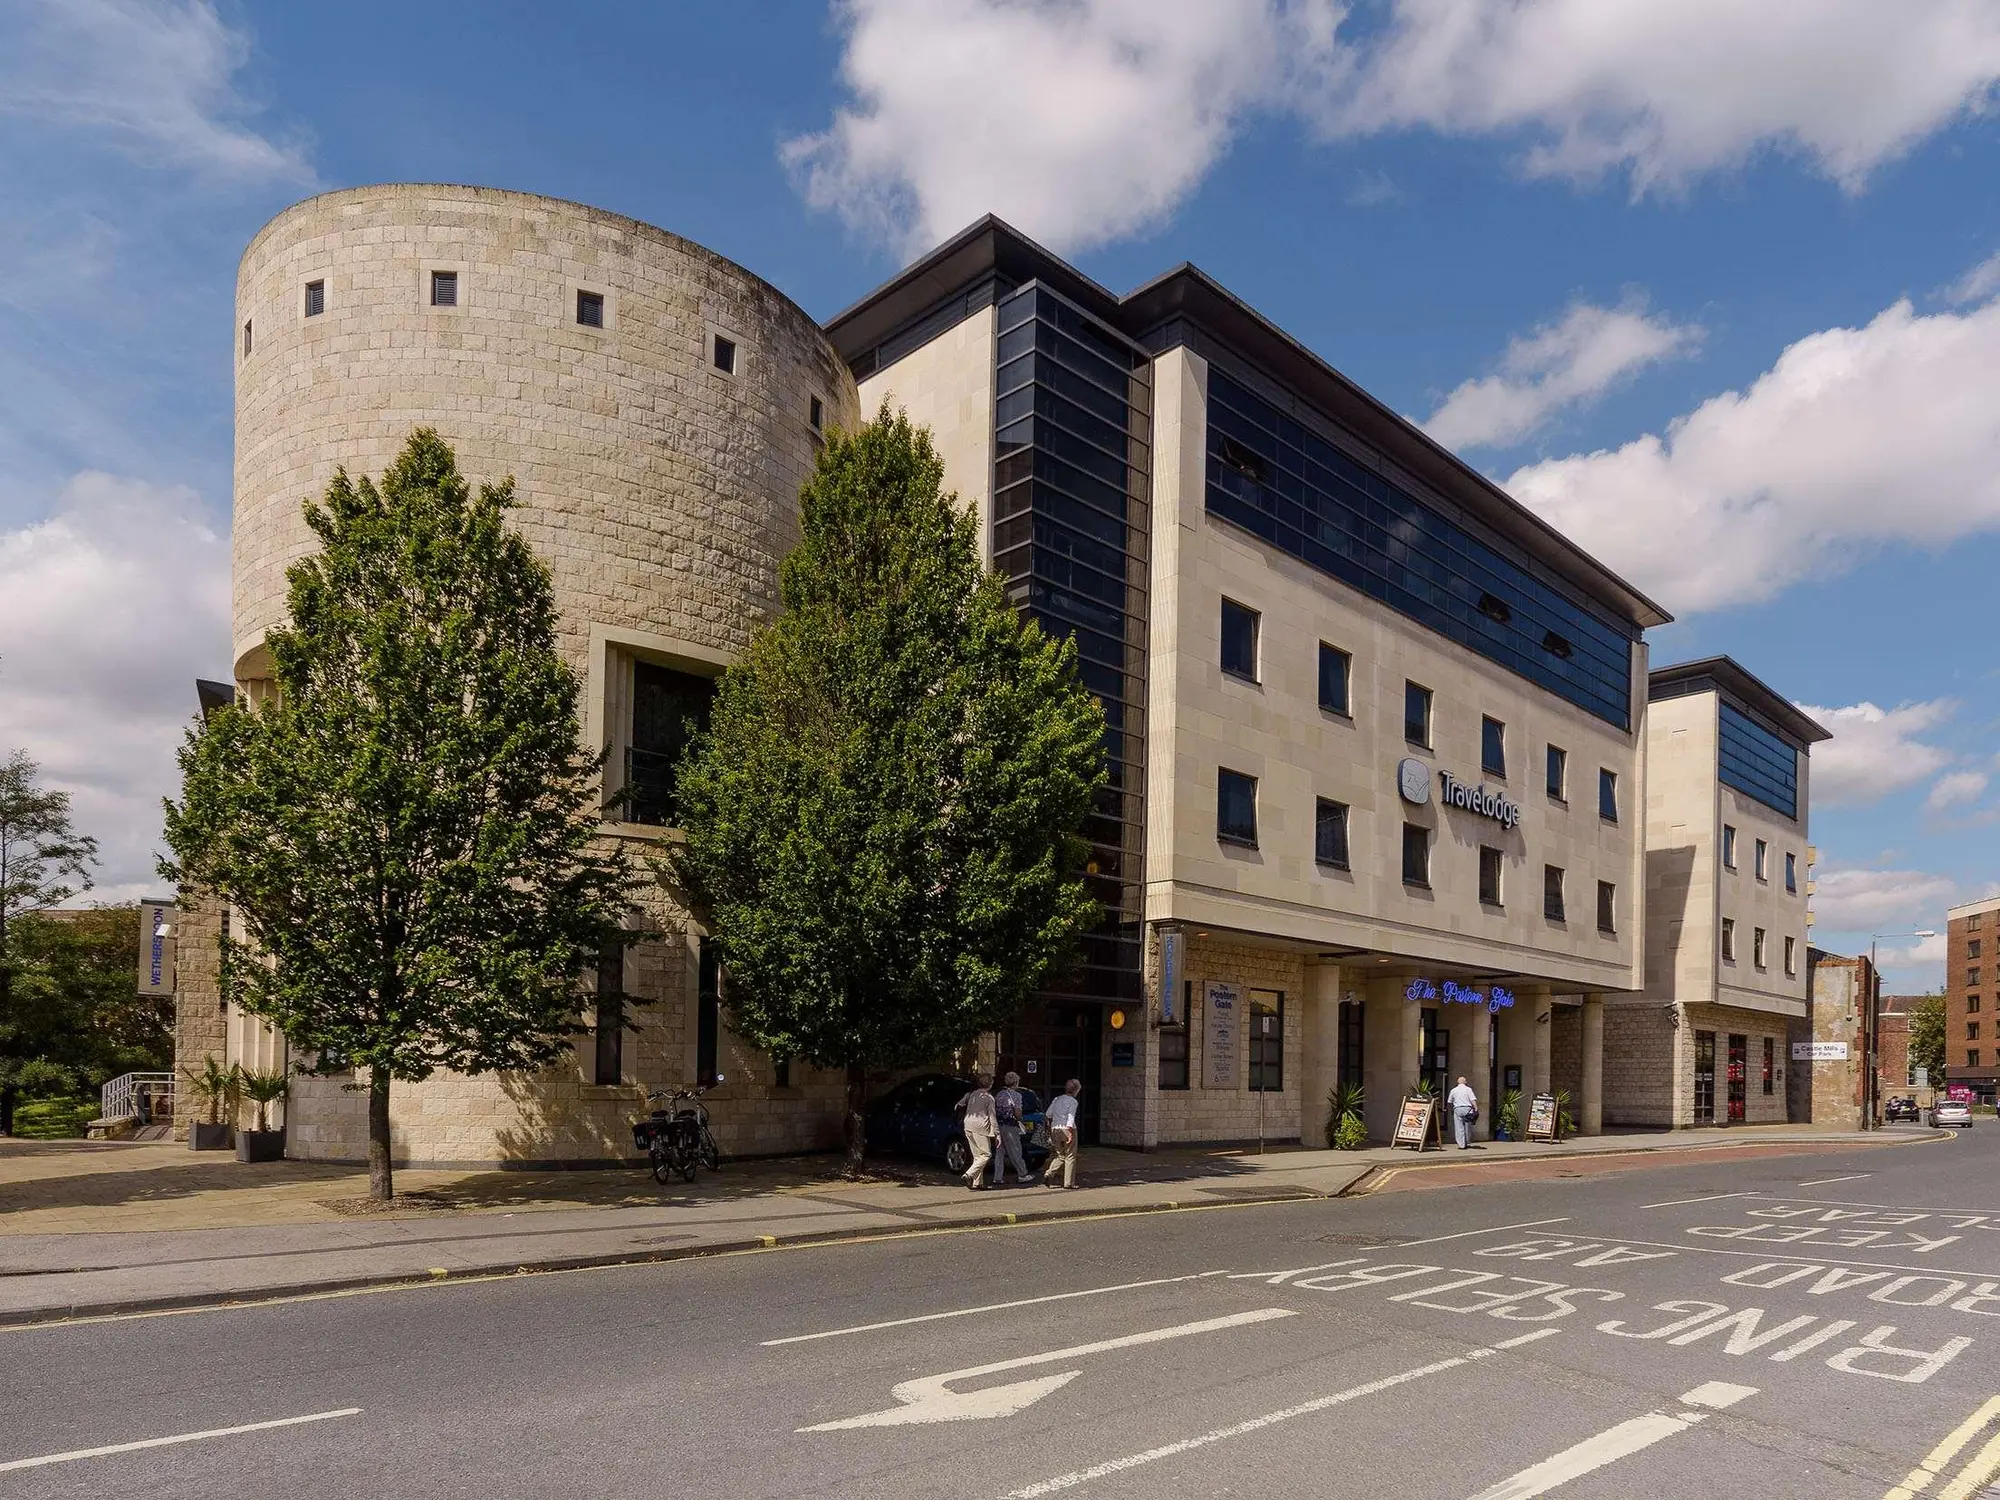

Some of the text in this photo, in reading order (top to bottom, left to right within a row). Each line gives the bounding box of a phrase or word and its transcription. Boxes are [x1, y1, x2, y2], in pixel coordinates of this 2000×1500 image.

[1438, 769, 1521, 830] Travelodge
[1210, 989, 1237, 1000] Postern
[1215, 999, 1232, 1009] Gate
[1406, 978, 1515, 1013] The Postern Gate
[1472, 1239, 1681, 1268] A19
[1686, 1223, 1963, 1252] KEEP
[1226, 1258, 1626, 1322] SELBY
[1596, 1301, 1974, 1383] RING
